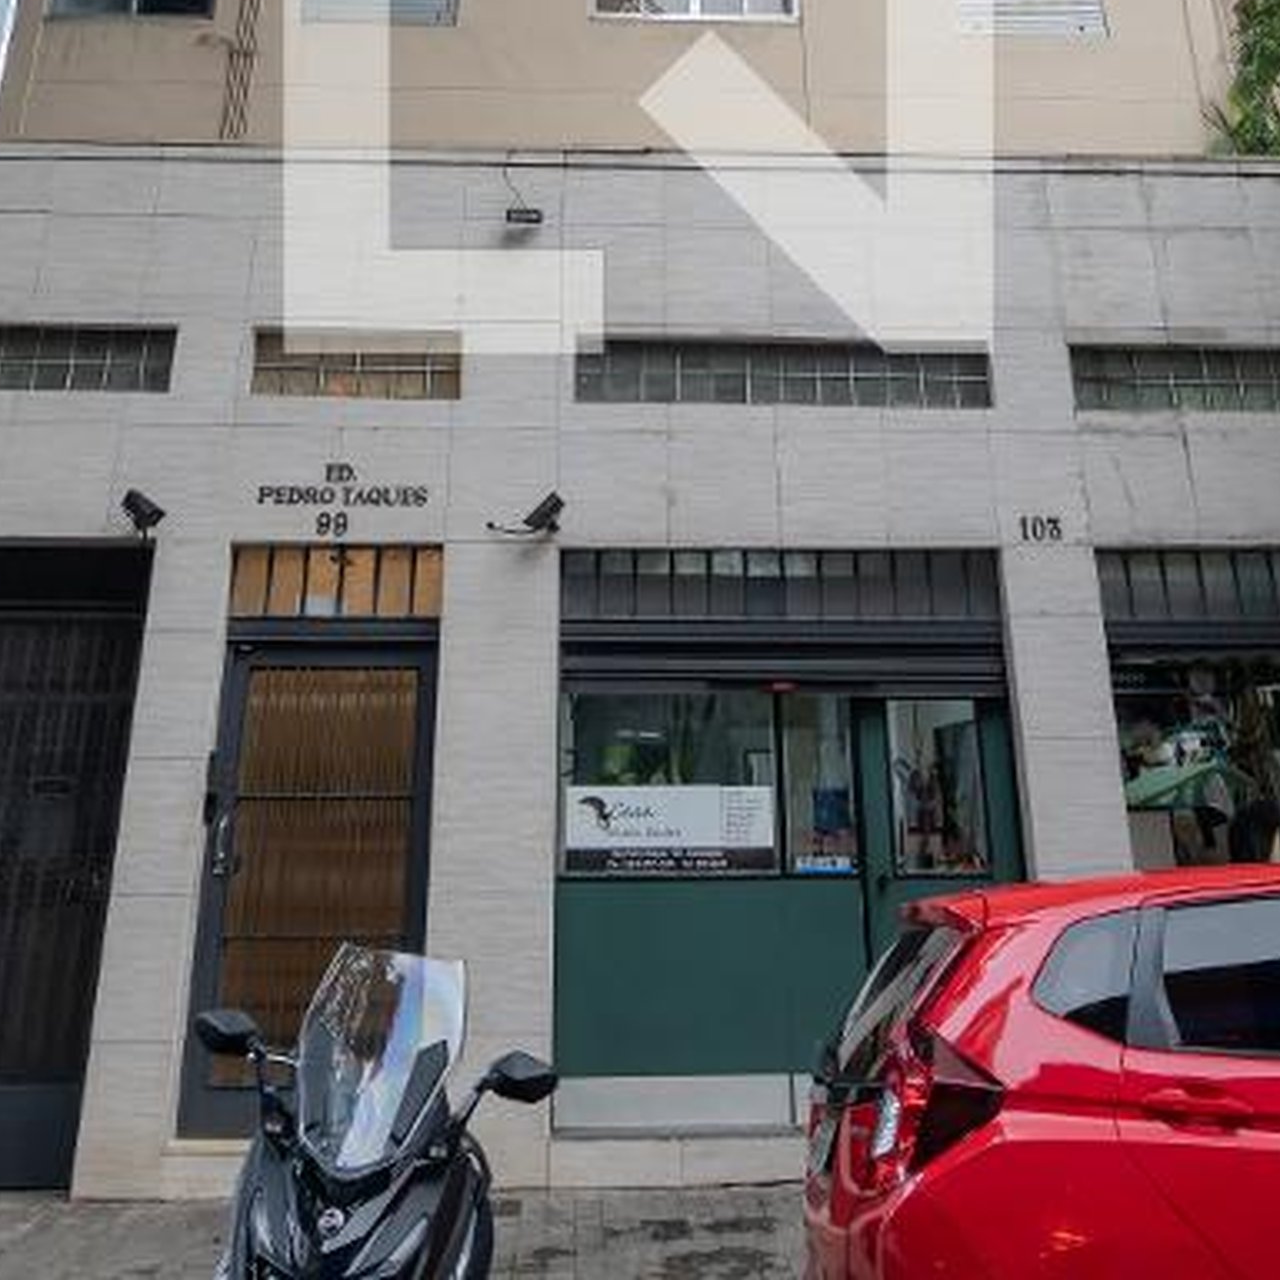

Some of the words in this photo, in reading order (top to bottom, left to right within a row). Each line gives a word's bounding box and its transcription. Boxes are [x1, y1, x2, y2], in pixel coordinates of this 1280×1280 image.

[325, 463, 358, 483] ED.
[257, 485, 336, 505] PEDRO
[342, 486, 429, 507] TAQUES
[316, 511, 349, 537] 99
[1020, 515, 1063, 541] 103
